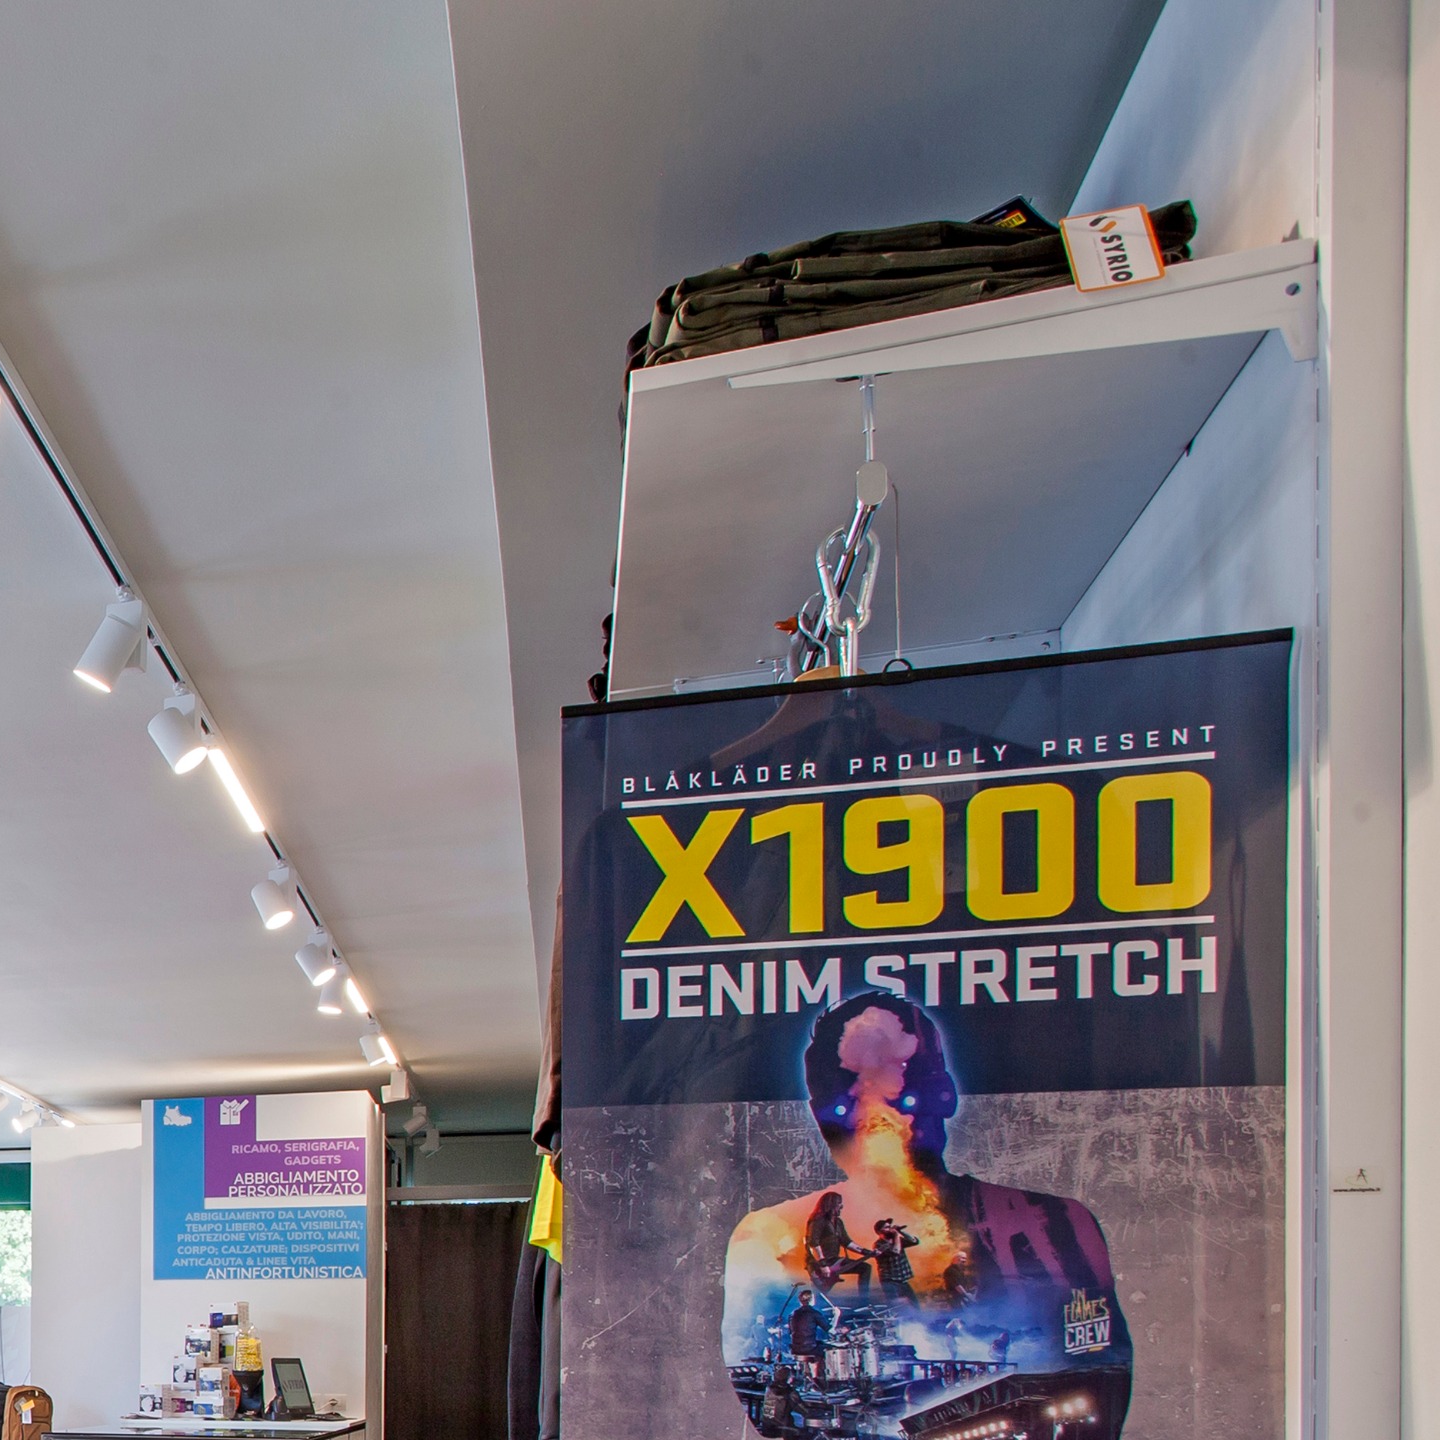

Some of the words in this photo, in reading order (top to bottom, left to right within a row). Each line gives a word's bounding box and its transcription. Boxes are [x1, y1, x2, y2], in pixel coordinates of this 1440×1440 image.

[1101, 234, 1133, 283] SYRIO
[622, 759, 818, 794] BLÅKLÄDER
[849, 745, 1009, 776] PROUDLY
[1042, 725, 1218, 757] PRESENT
[626, 771, 1212, 943] X1900
[621, 955, 843, 1021] DENIM
[863, 936, 1218, 1006] STRETCH
[231, 1143, 282, 1156] RICAMO,
[284, 1141, 360, 1154] SERIGRAFIA,
[284, 1155, 342, 1167] GADGETS
[233, 1169, 359, 1185] ABBIGLIAMENTO
[228, 1183, 364, 1198] PERSONALIZZATO
[185, 1210, 275, 1222] ABBIGLIAMENTO
[278, 1210, 294, 1220] DA
[297, 1209, 348, 1221] LAVORO,
[185, 1222, 223, 1233] TEMPO
[271, 1221, 297, 1231] ALTA
[177, 1232, 245, 1243] PROTEZIONE
[248, 1231, 284, 1243] VISTA,
[287, 1231, 324, 1242] UDITO,
[327, 1231, 360, 1242] MANI,
[291, 1243, 360, 1254] DISPOSITIVI
[172, 1257, 244, 1268] ANTICADUTA
[246, 1256, 254, 1267] &
[257, 1256, 288, 1266] LINEE
[290, 1256, 316, 1266] VITA
[205, 1266, 364, 1281] ANTINFORTUNISTICA
[1065, 1320, 1111, 1349] CREW
